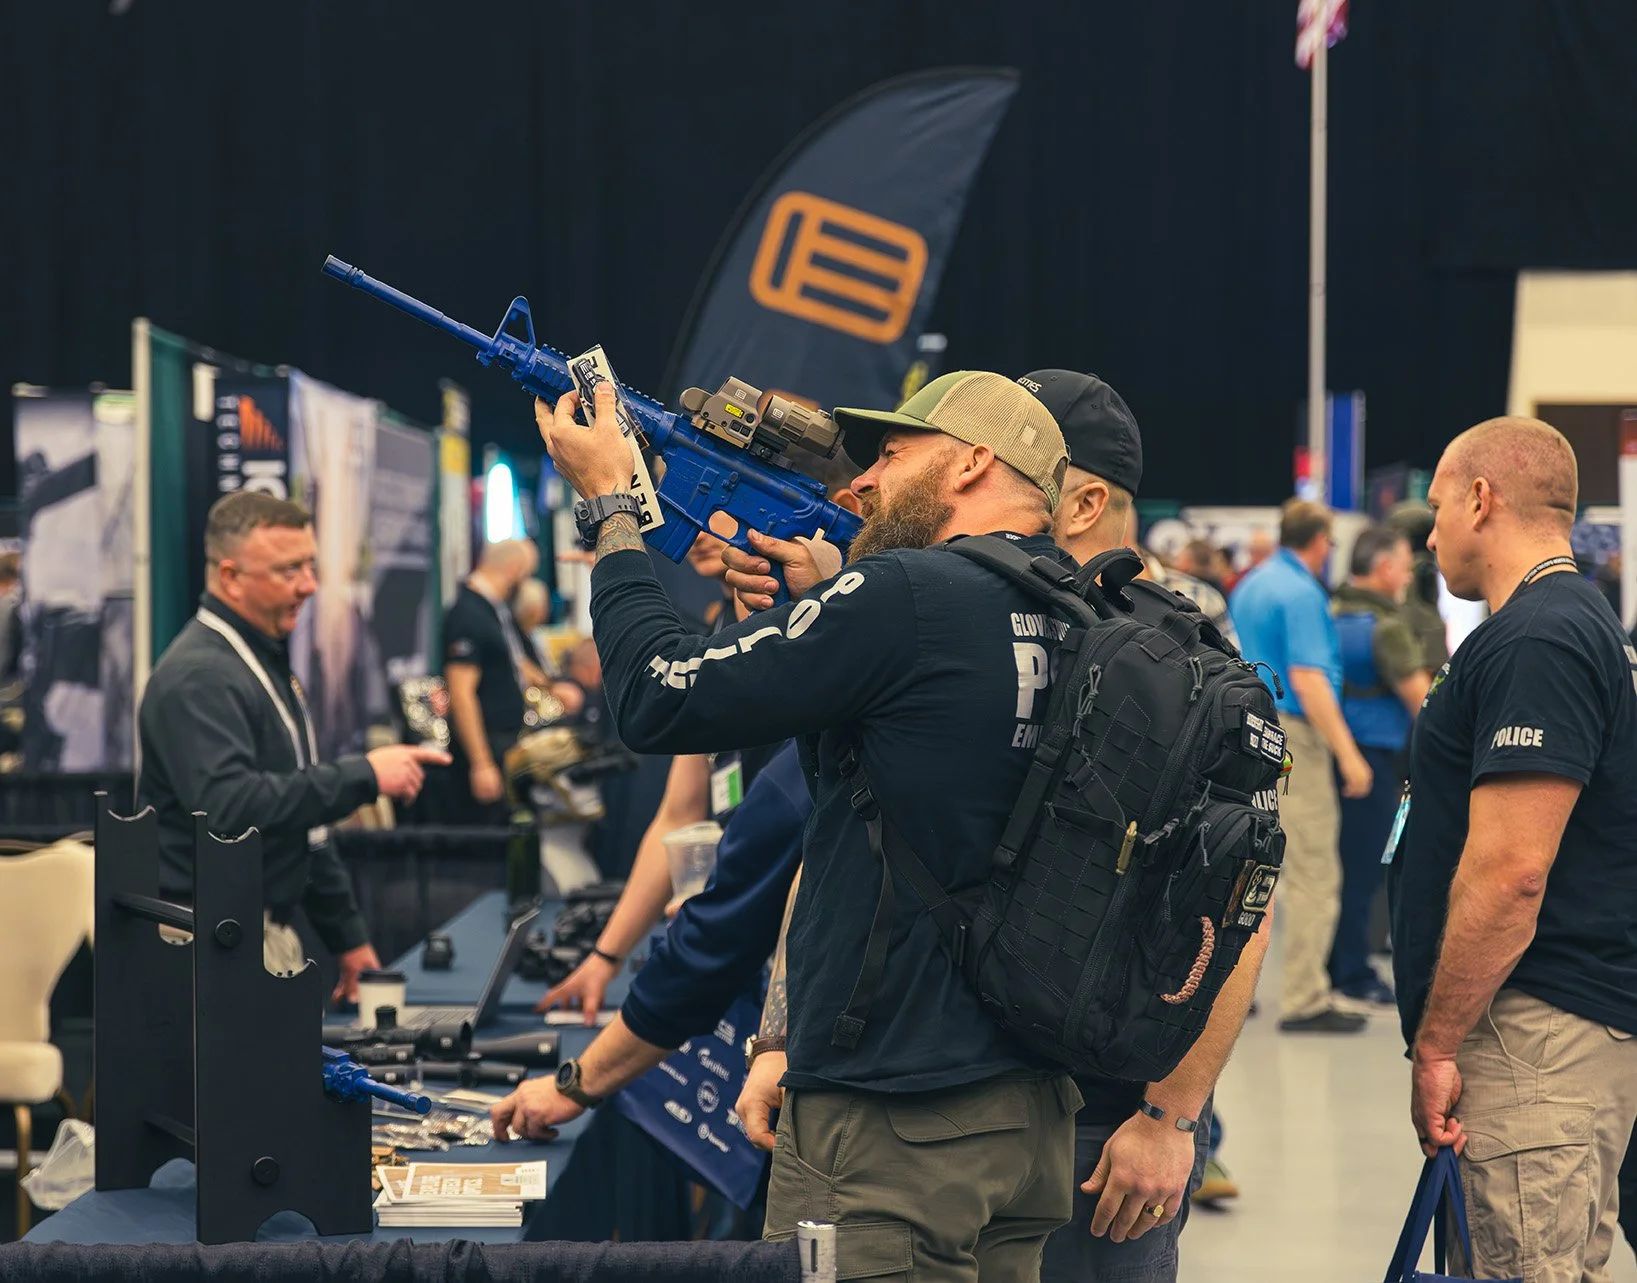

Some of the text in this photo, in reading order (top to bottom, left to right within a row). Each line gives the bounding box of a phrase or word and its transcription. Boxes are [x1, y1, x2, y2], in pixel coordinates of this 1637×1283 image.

[644, 571, 865, 690] POLICE
[1490, 726, 1544, 750] POLICE
[1251, 789, 1279, 811] LICE
